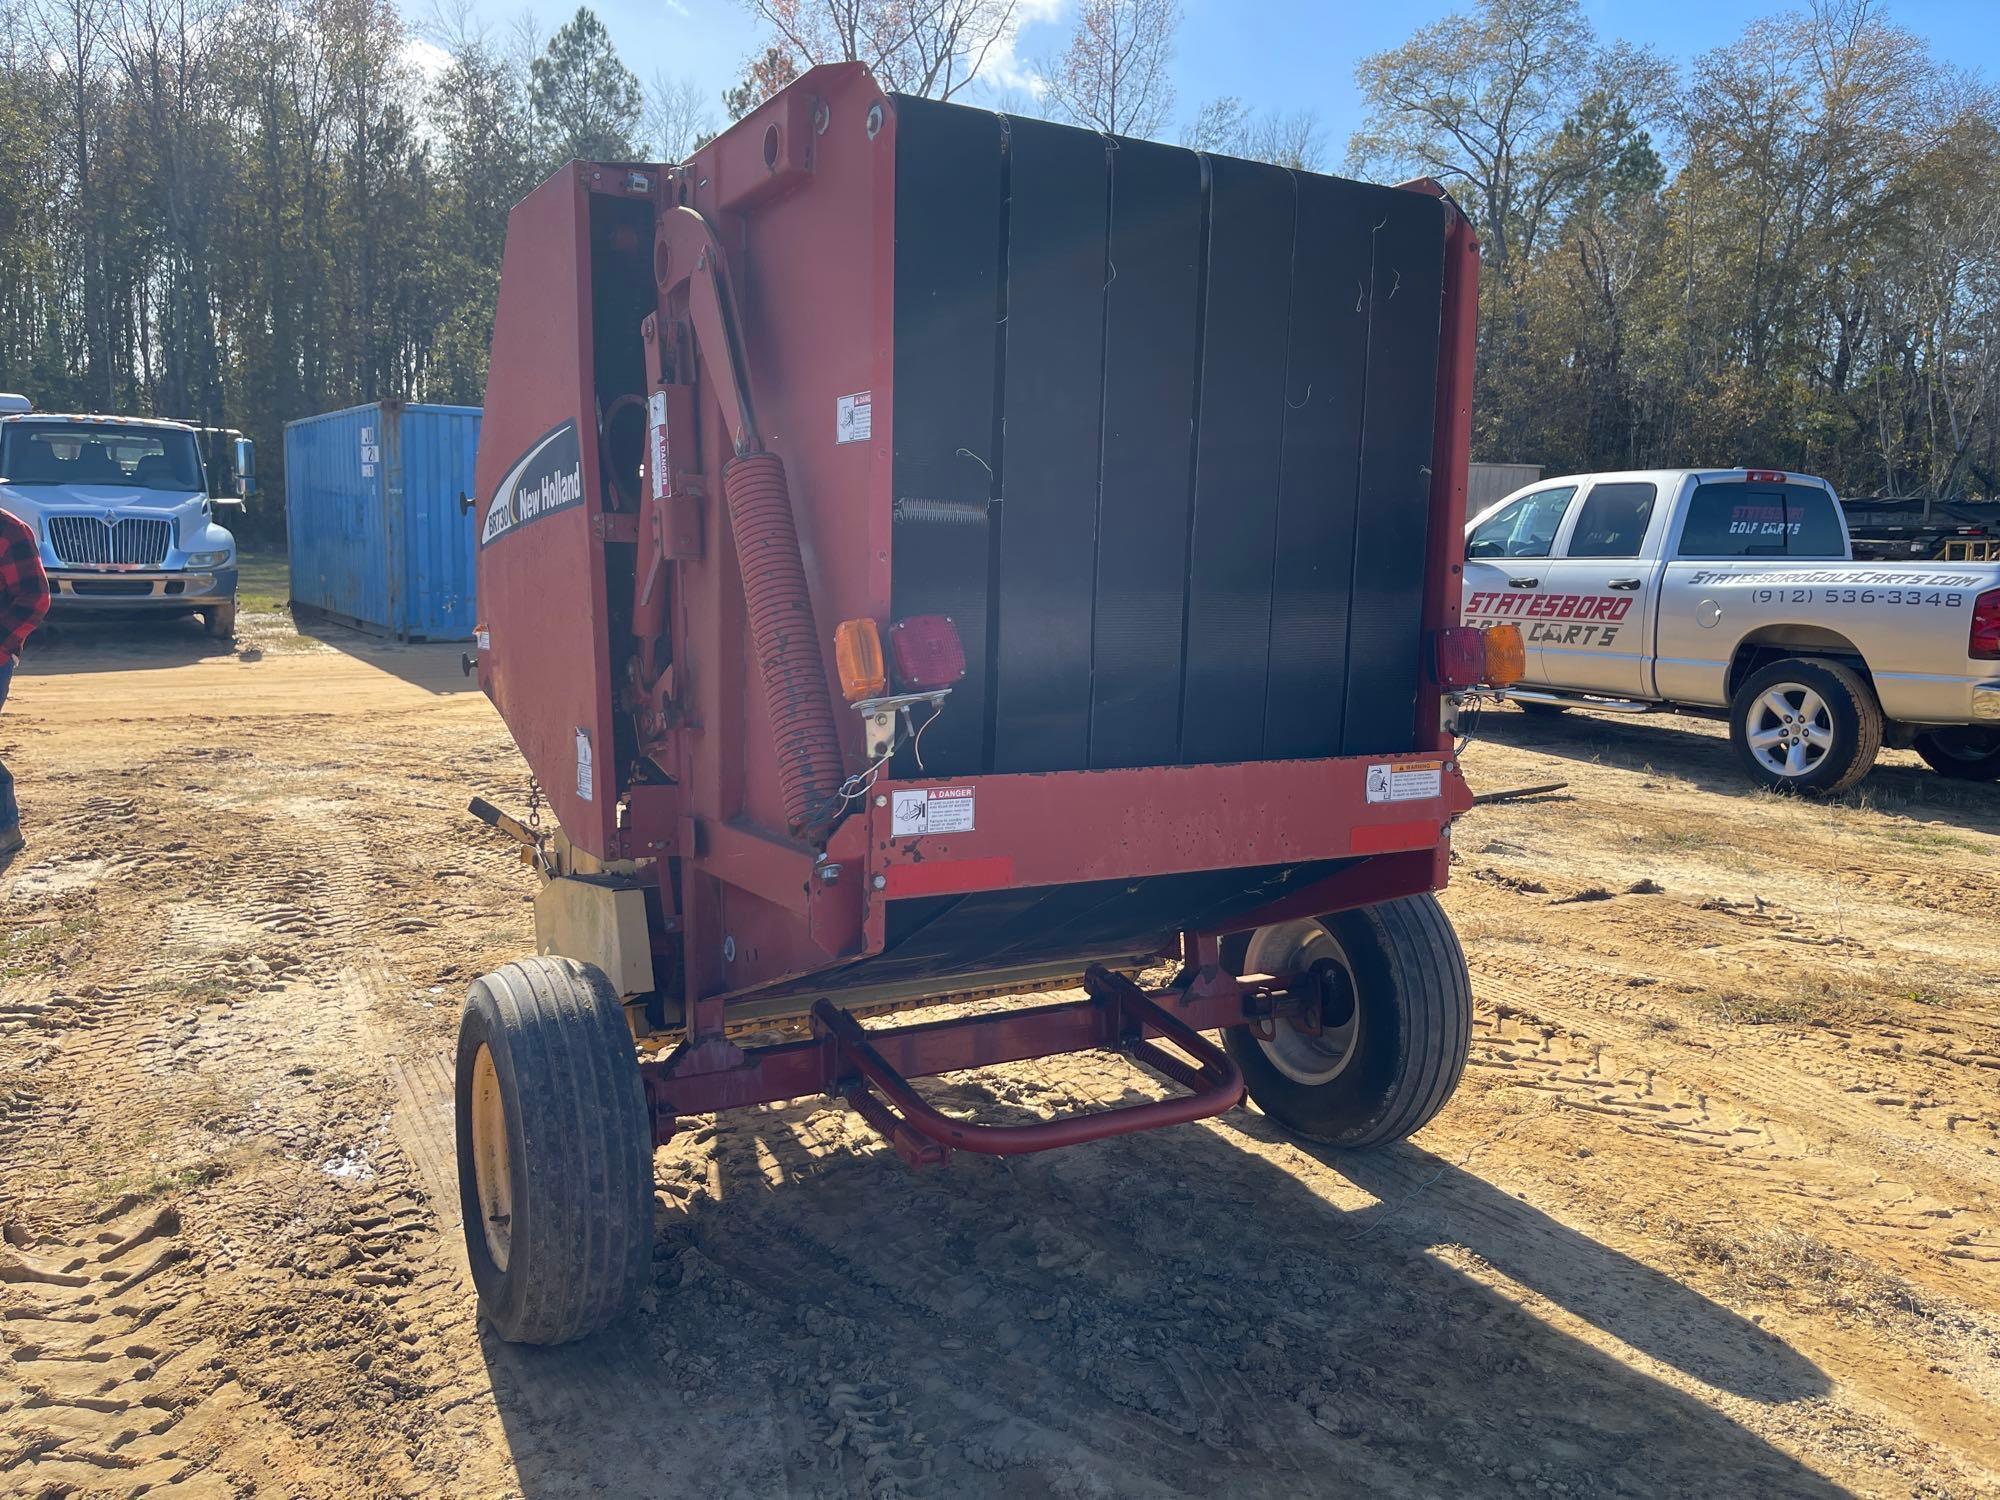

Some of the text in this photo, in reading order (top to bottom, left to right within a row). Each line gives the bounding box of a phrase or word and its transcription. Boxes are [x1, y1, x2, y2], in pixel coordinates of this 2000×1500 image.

[660, 445, 668, 485] DANGER
[519, 461, 581, 522] New Holland
[1729, 522, 1800, 535] GOLF CARTS
[1465, 592, 1633, 620] STATESBORO
[1751, 589, 1963, 607] (912) 536-3348
[939, 789, 972, 798] DANGER
